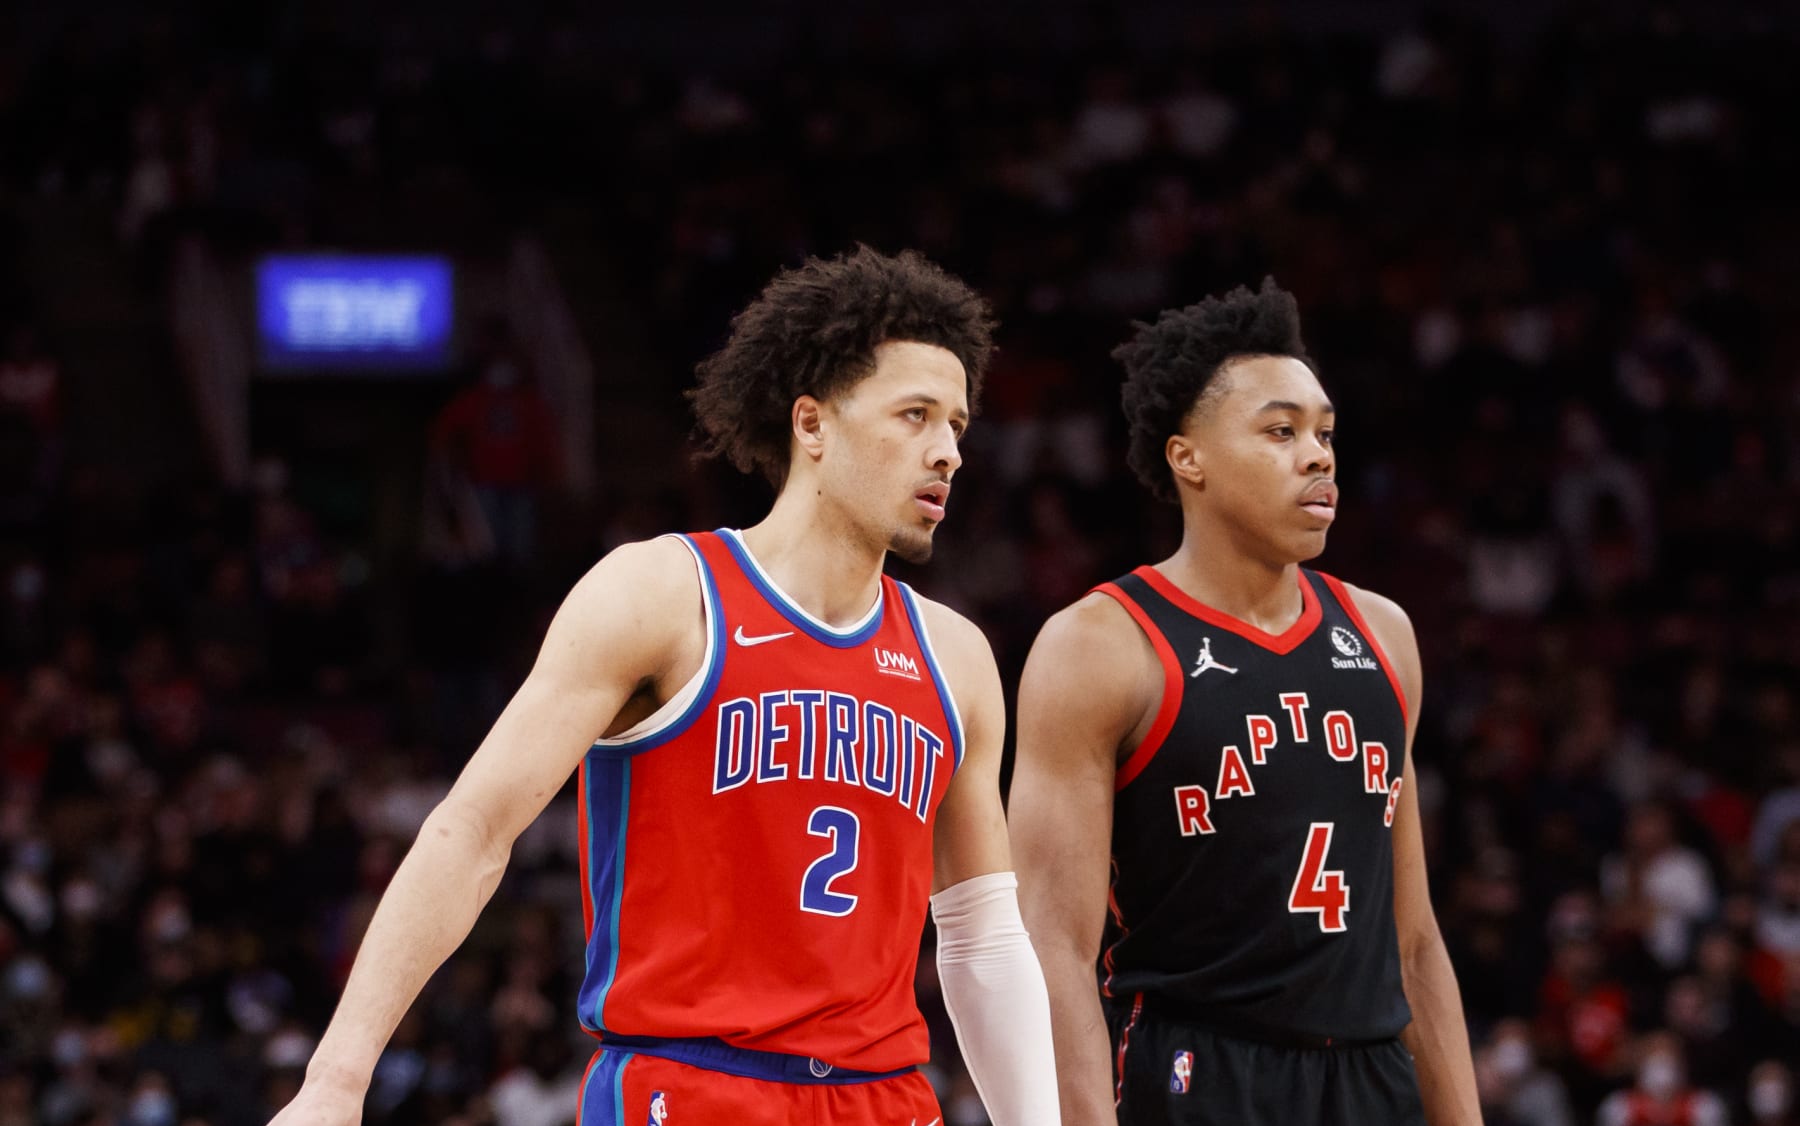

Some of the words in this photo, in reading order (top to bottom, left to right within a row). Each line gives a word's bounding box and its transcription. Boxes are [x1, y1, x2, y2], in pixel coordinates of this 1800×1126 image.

[874, 647, 919, 675] UWM
[1331, 656, 1356, 669] Sun
[1355, 657, 1377, 670] Life
[713, 690, 943, 823] DETROIT
[1174, 692, 1402, 837] RAPTORS
[800, 805, 860, 917] 2
[1288, 822, 1350, 933] 4
